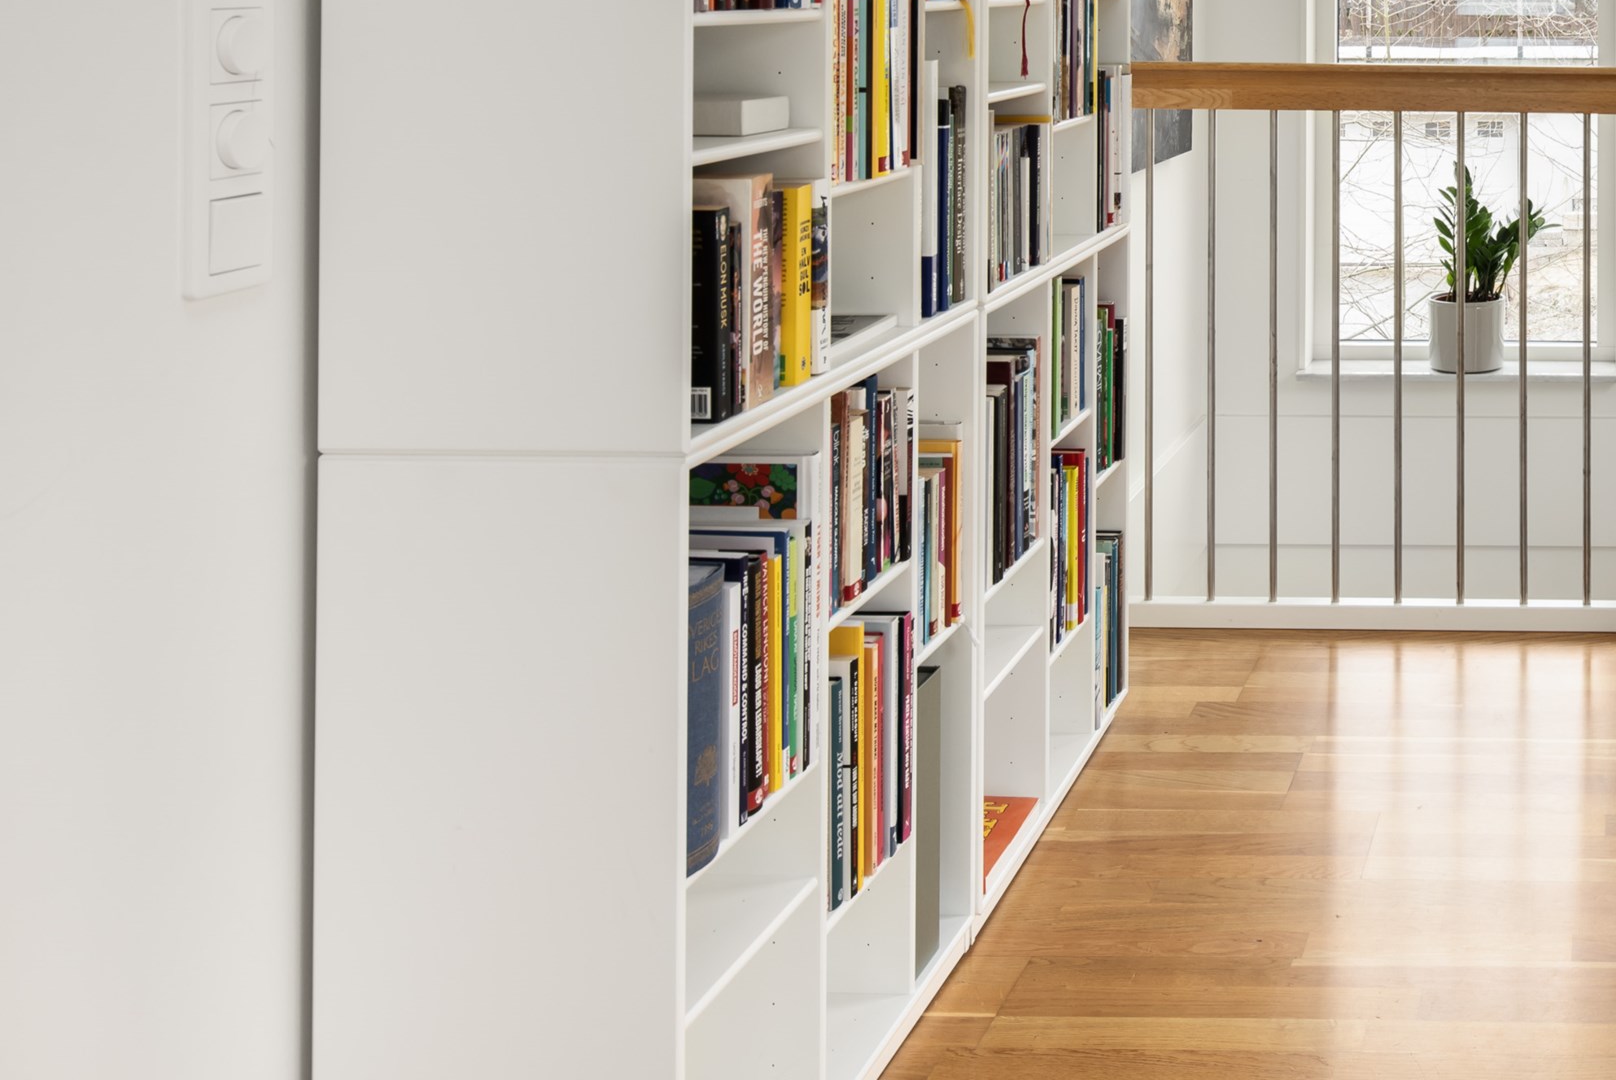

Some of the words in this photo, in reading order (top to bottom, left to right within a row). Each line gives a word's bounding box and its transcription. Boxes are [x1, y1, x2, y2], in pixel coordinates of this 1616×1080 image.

[753, 228, 763, 271] THE
[955, 211, 963, 255] Design
[719, 243, 727, 285] ELON
[798, 279, 810, 297] SOL
[719, 286, 727, 329] MUSK
[753, 273, 763, 356] WORLD
[763, 339, 769, 351] OF
[832, 429, 841, 466] blink
[695, 630, 718, 657] RIKES
[692, 647, 720, 682] LAG
[836, 751, 844, 789] Mod
[836, 822, 844, 860] leda
